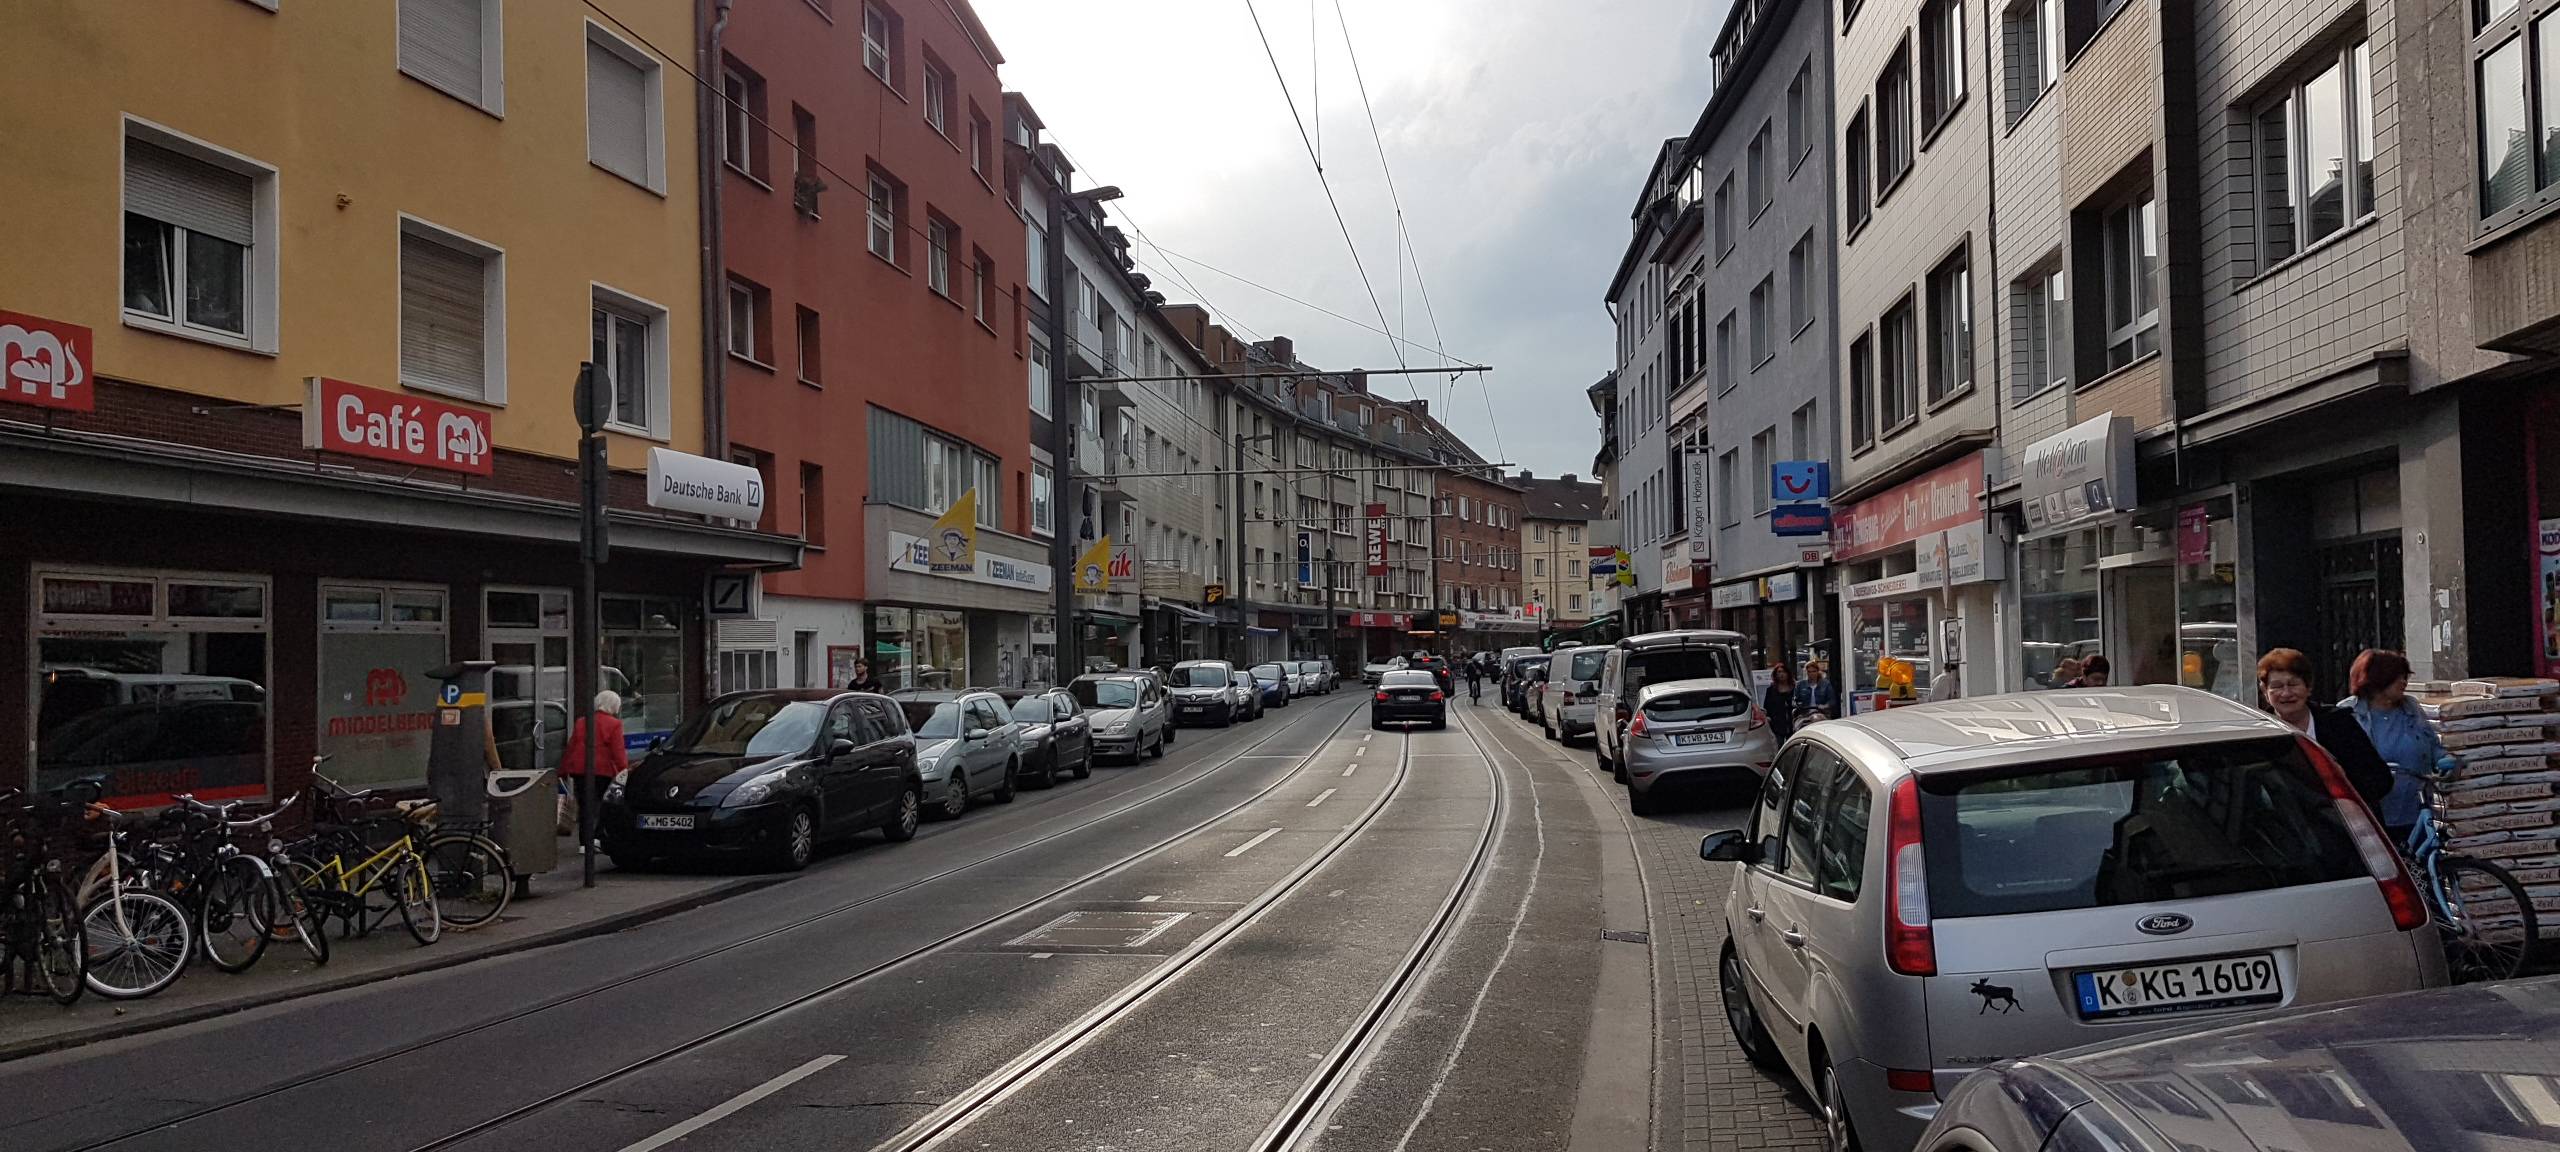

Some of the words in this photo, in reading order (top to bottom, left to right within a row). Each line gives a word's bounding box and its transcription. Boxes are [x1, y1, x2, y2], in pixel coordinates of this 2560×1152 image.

[337, 394, 425, 454] Café
[664, 474, 714, 500] Deutsche
[717, 484, 742, 505] Bank
[1367, 519, 1382, 566] REWE
[1804, 552, 1818, 561] DB
[931, 563, 973, 573] ZEEMAN
[992, 560, 1015, 581] ZEEMAN
[447, 684, 459, 704] P
[670, 816, 693, 827] 5402
[2150, 915, 2181, 929] Ford
[2096, 974, 2122, 1006] K
[2140, 968, 2186, 1001] KG
[2191, 959, 2271, 996] 1609
